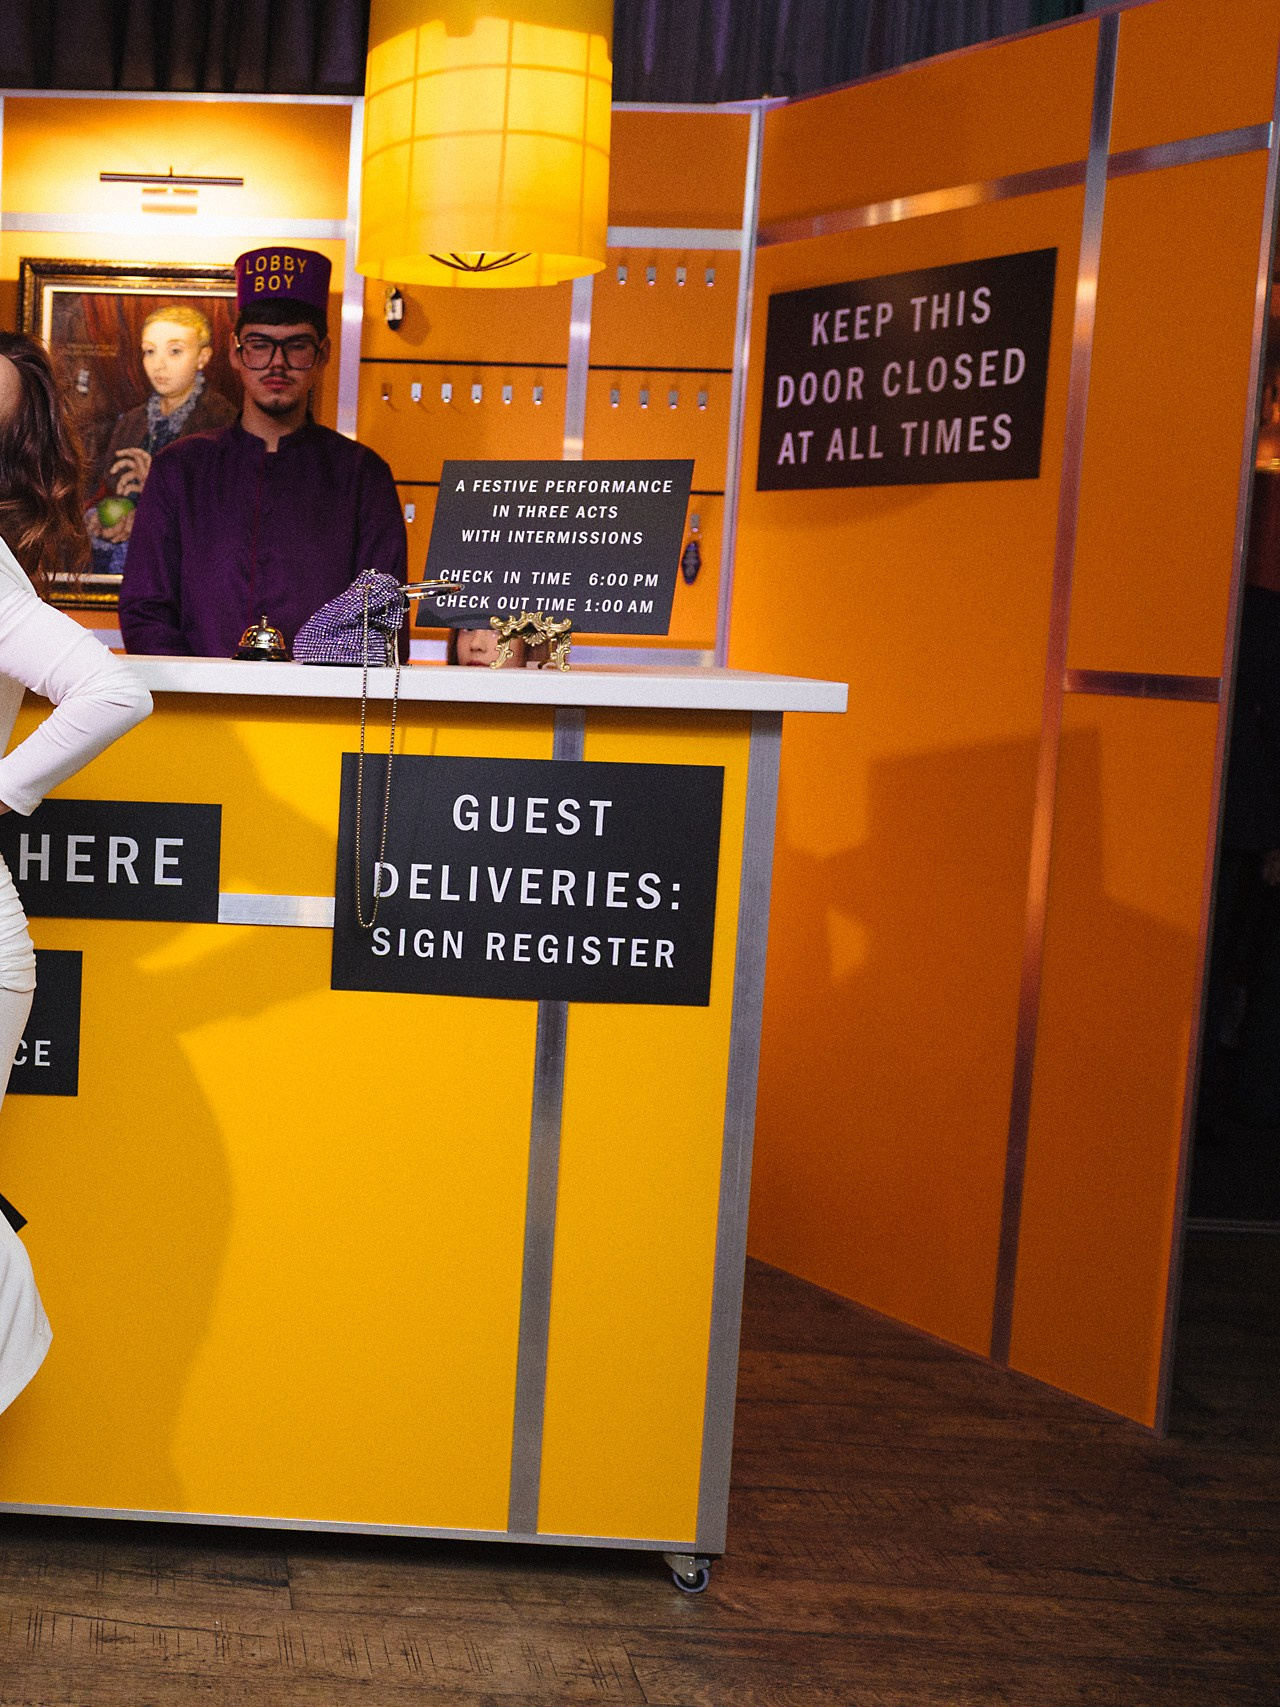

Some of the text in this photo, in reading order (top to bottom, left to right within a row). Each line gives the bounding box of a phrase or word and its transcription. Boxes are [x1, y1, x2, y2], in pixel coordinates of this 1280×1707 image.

[245, 255, 307, 274] LOBBY
[254, 274, 294, 292] BOY
[811, 286, 992, 346] KEEP THIS
[776, 348, 1026, 408] DOOR CLOSED
[777, 413, 1013, 465] AT ALL TIMES
[456, 480, 673, 493] A FESTIVE PERFORMANCE
[492, 505, 618, 519] IN THREE ACTS
[462, 530, 643, 544] WITH INTERMISSIONS
[440, 569, 493, 583] CHECK
[503, 571, 521, 584] IN
[532, 572, 572, 585] TIME
[436, 595, 490, 608] CHECK
[497, 597, 530, 611] OUT
[536, 598, 576, 612] TIME
[452, 794, 613, 836] GUEST
[20, 833, 184, 886] HERE
[373, 862, 681, 910] DELIVERIES:
[371, 927, 675, 969] SIGN REGISTER
